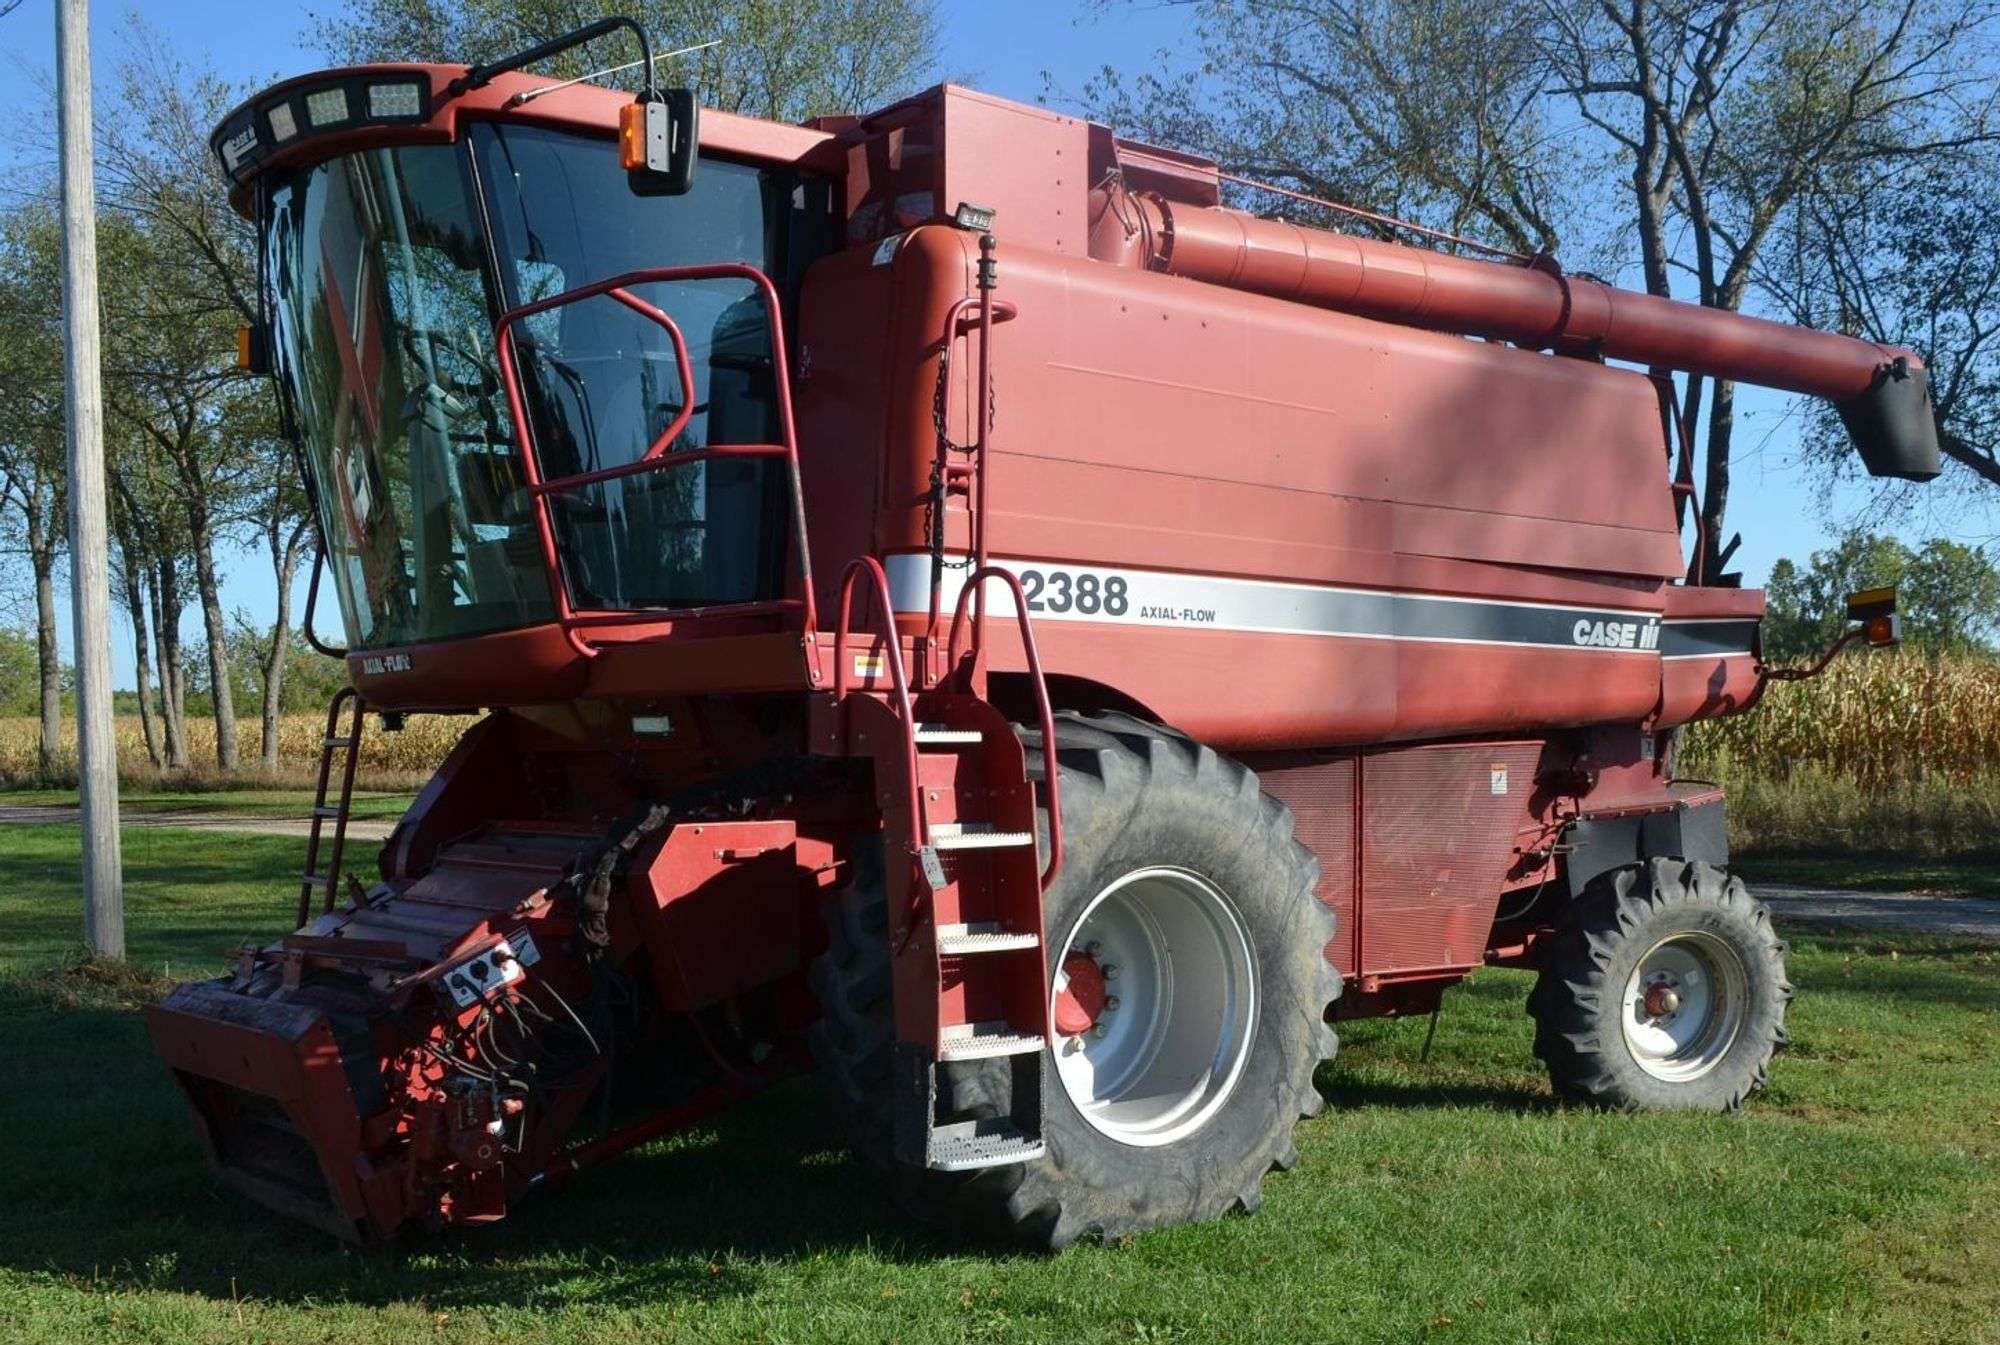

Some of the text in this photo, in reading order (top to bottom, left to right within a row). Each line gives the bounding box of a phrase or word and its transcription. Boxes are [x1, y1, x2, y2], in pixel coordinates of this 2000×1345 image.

[1020, 570, 1129, 616] 2388
[1140, 606, 1216, 622] AXIAL-FLOW
[1573, 619, 1637, 647] CASE
